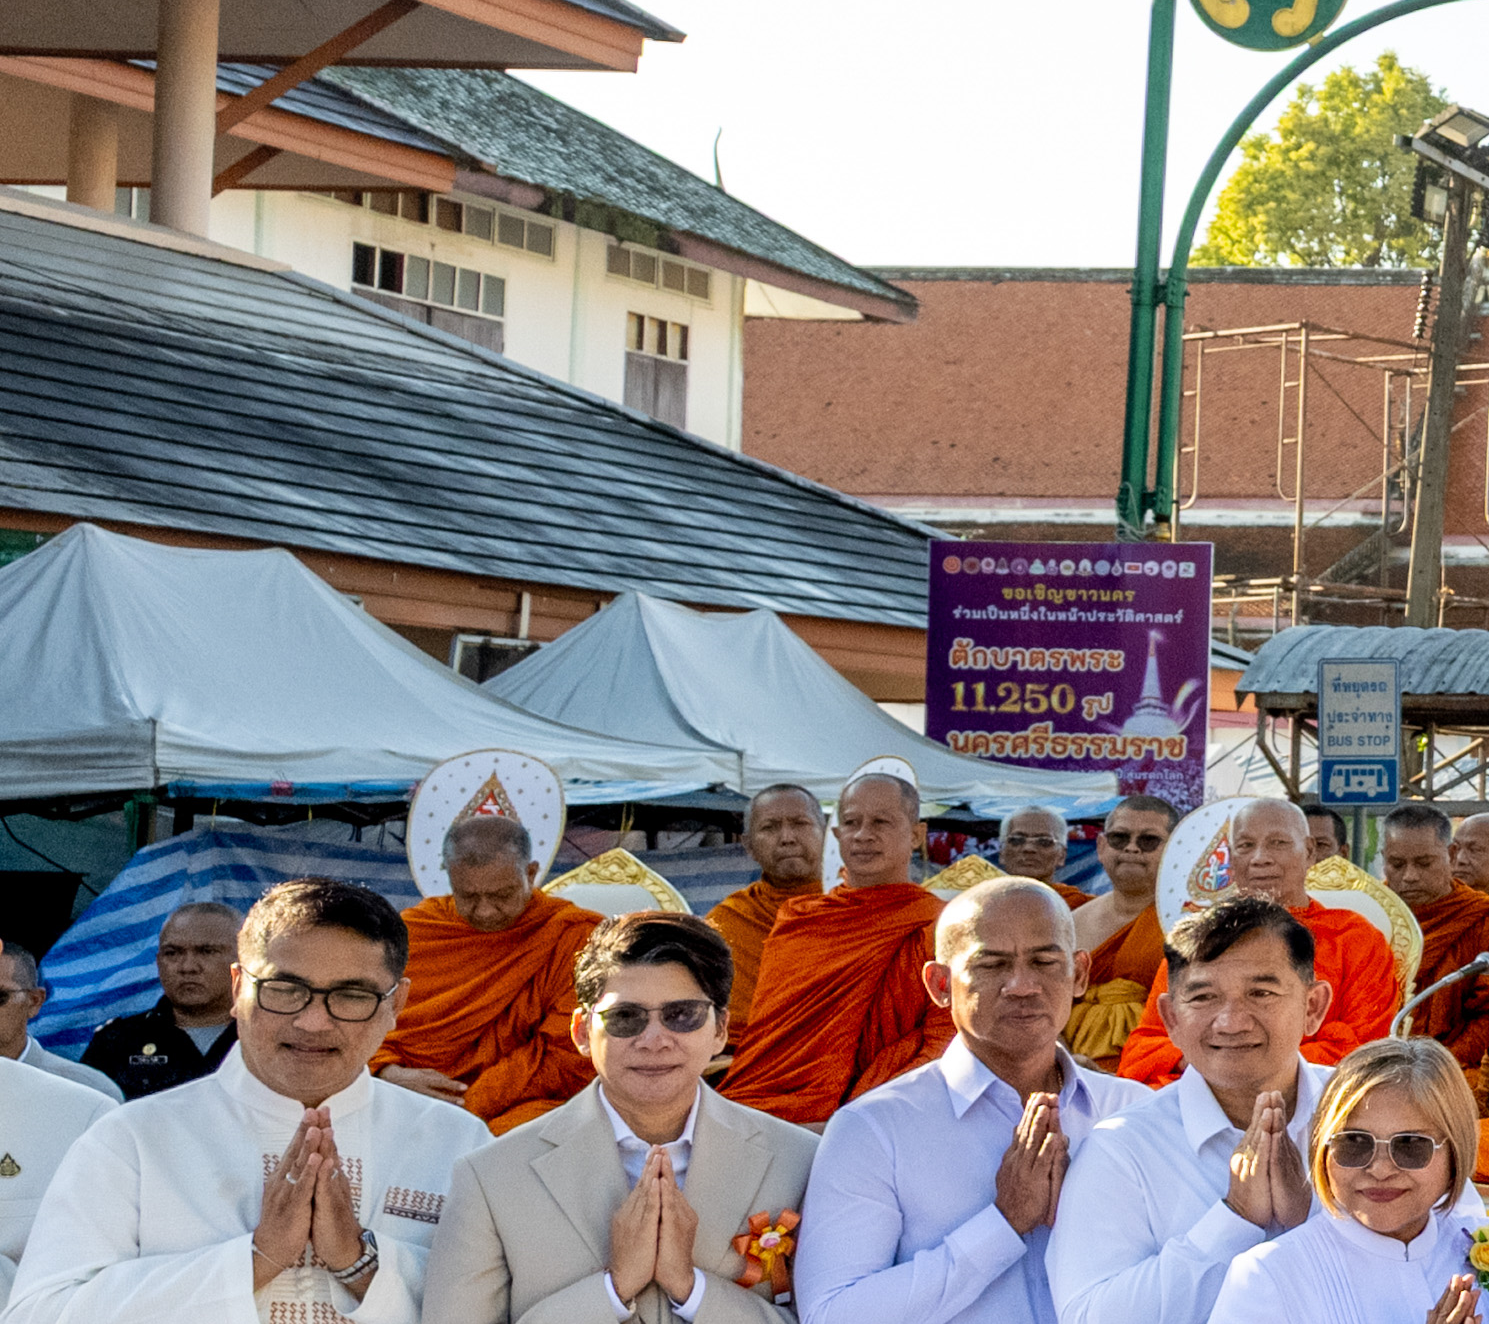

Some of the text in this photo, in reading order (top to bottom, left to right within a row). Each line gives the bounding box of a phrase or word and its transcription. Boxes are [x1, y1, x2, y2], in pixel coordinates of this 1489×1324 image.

[953, 603, 1183, 623] ร่วมเป็นหนึ่งในหน้าประวัติศาสตร์
[949, 637, 1125, 671] ตักบาตรพระ
[1332, 674, 1388, 699] ที่หยุดรถ
[1082, 692, 1113, 720] รูป
[949, 723, 1186, 760] นครศรีธรรมราช
[1328, 735, 1391, 747] BUS STOP
